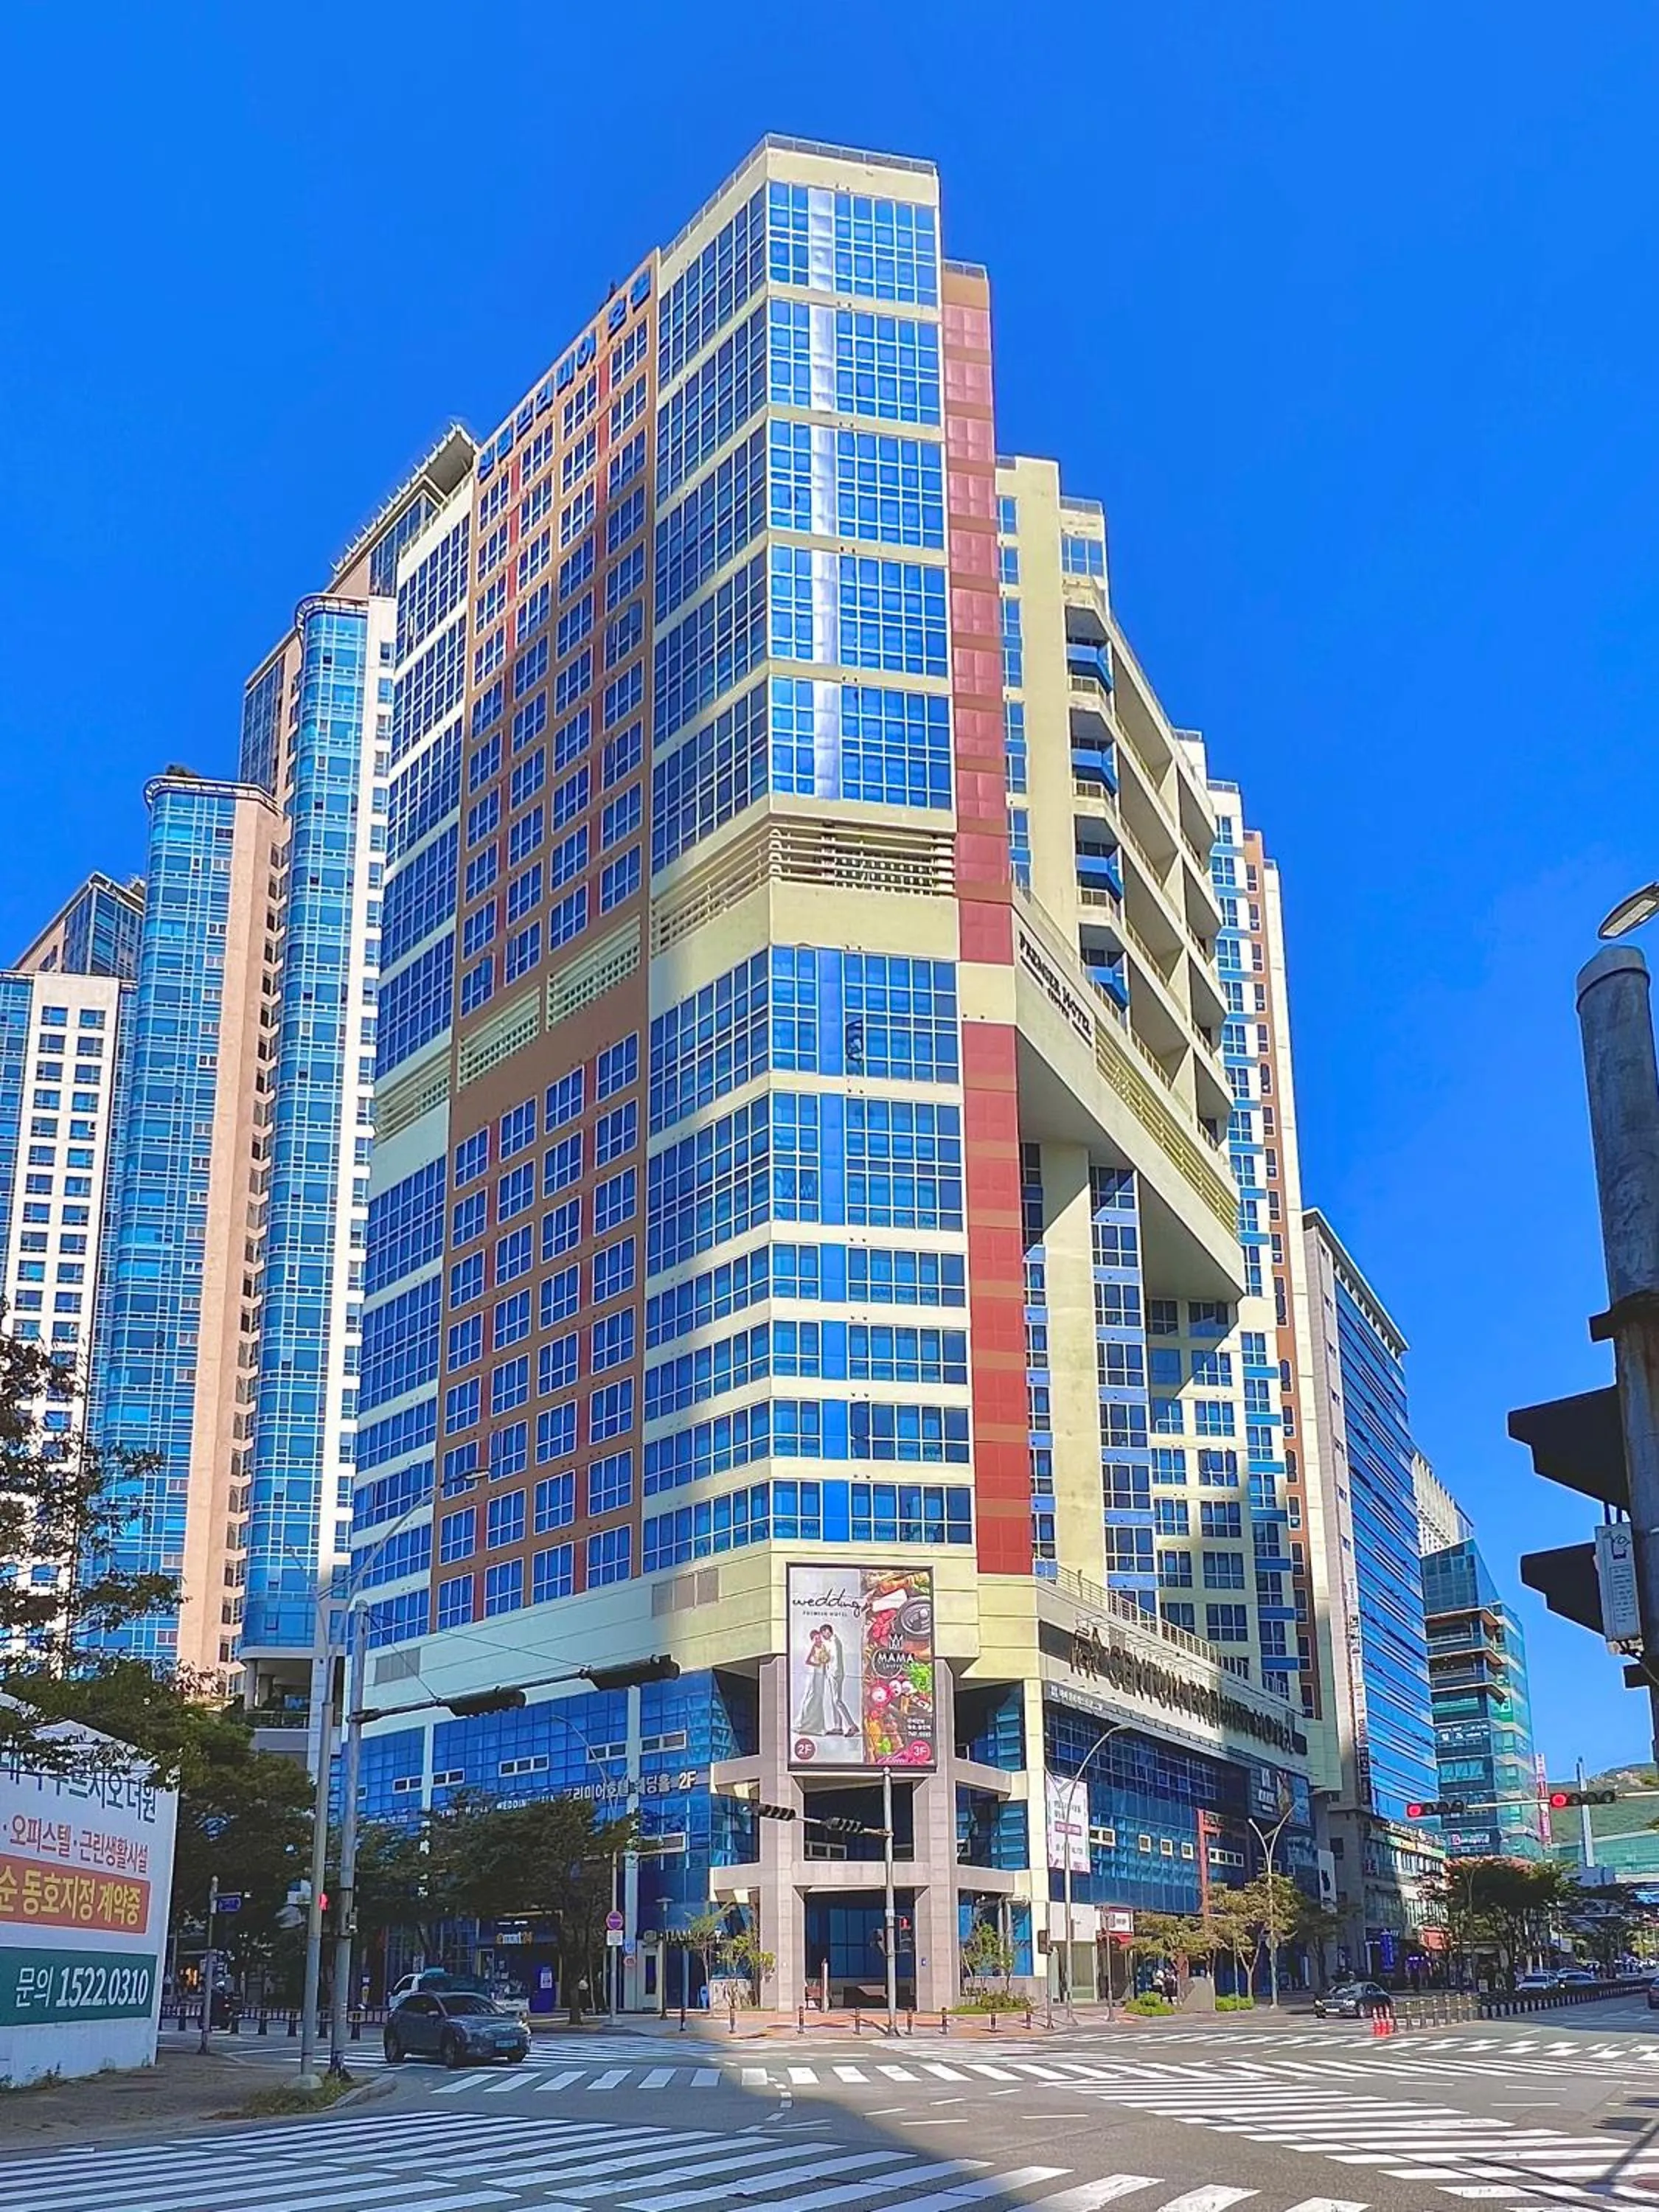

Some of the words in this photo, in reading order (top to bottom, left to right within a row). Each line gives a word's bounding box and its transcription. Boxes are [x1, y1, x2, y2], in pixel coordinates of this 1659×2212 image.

[1062, 985, 1091, 1037] HOTEL
[793, 1587, 862, 1618] wedding
[877, 1652, 915, 1663] MAMA
[796, 1743, 813, 1754] 2F
[913, 1745, 928, 1756] 3F
[678, 1770, 698, 1790] 2F
[23, 1870, 94, 1920] 동호지정
[97, 1881, 141, 1925] 계약중
[16, 1966, 54, 2008] 문의
[55, 1966, 148, 2007] 1522.0310
